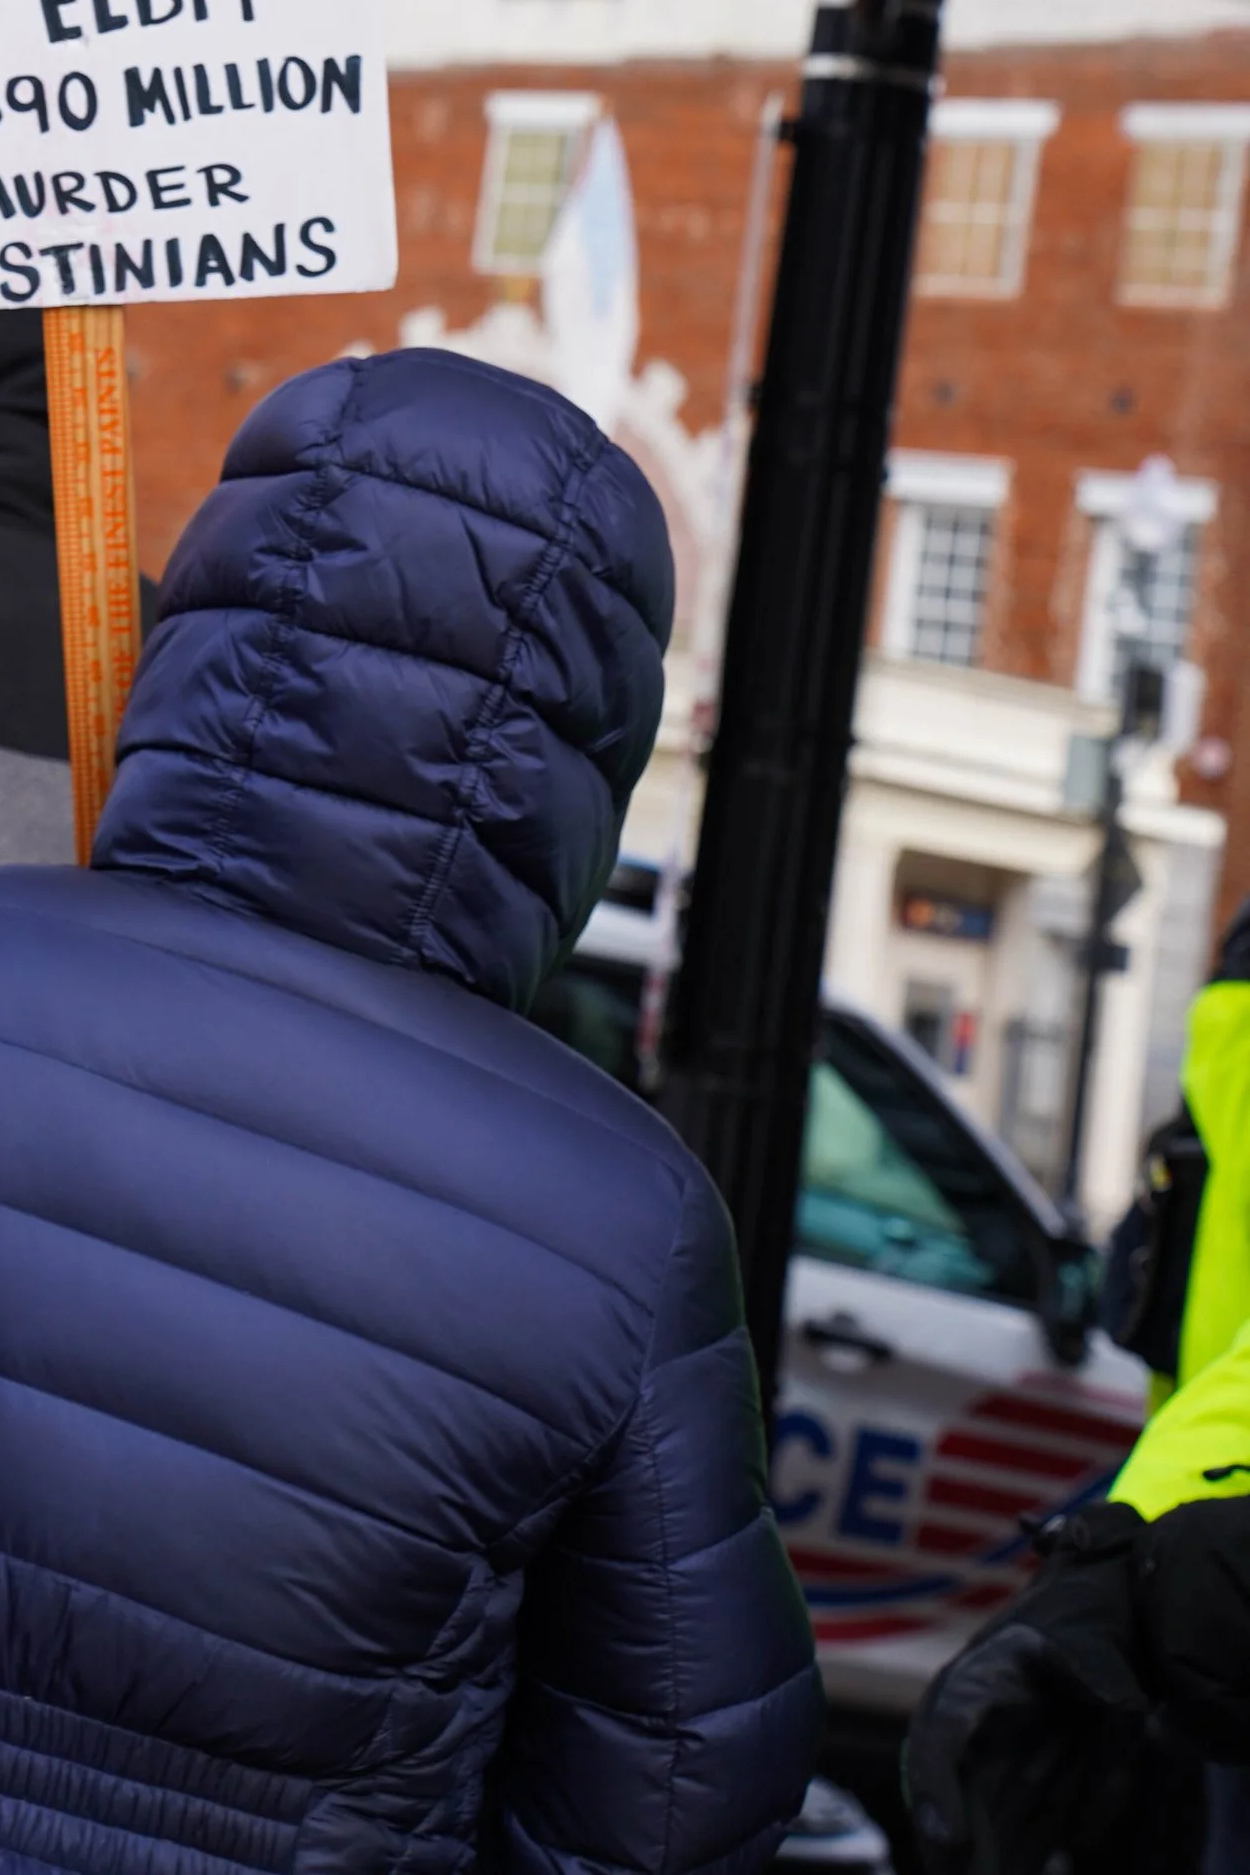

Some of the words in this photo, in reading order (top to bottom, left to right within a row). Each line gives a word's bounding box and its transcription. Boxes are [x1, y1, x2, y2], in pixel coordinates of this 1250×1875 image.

[124, 55, 361, 127] MILLION
[95, 347, 123, 456] PAINTS
[101, 469, 129, 570] FINEST
[107, 580, 132, 636] THE
